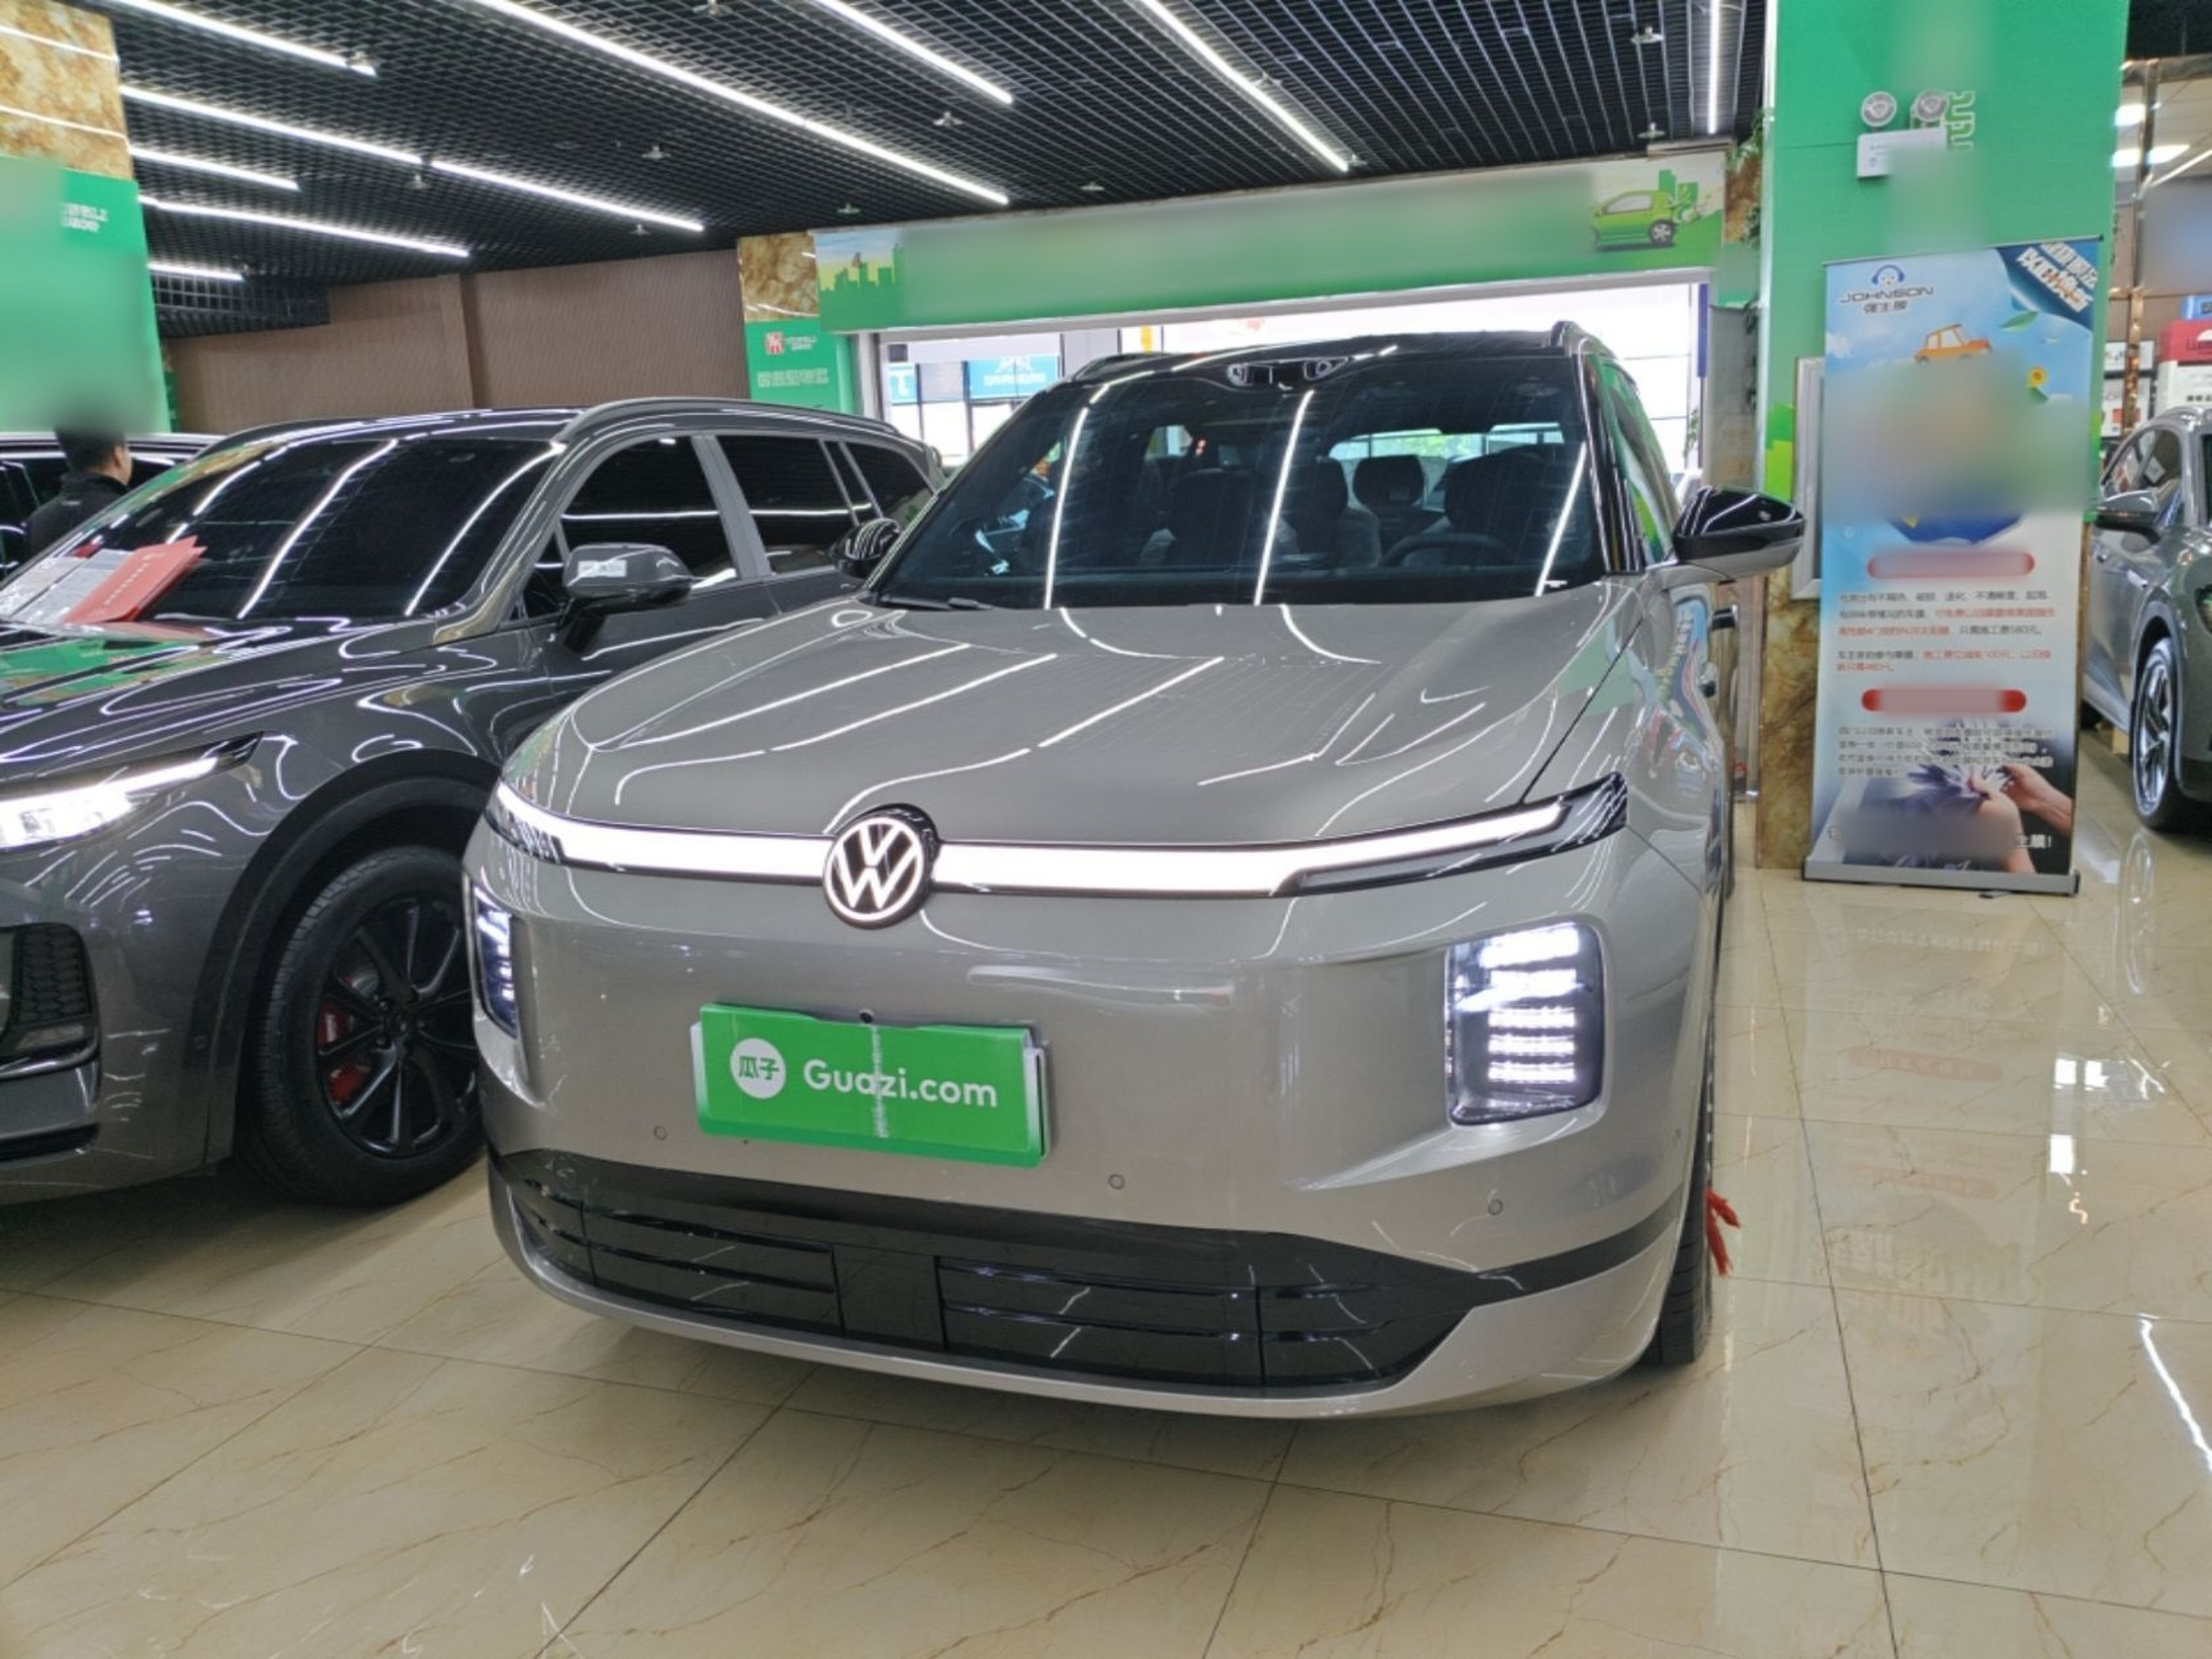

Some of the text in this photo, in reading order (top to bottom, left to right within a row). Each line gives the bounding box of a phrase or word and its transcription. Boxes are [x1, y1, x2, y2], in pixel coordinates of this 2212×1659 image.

[1840, 287, 1934, 303] JOHNSON
[738, 1055, 999, 1108] 瓜子 Guazi.com
